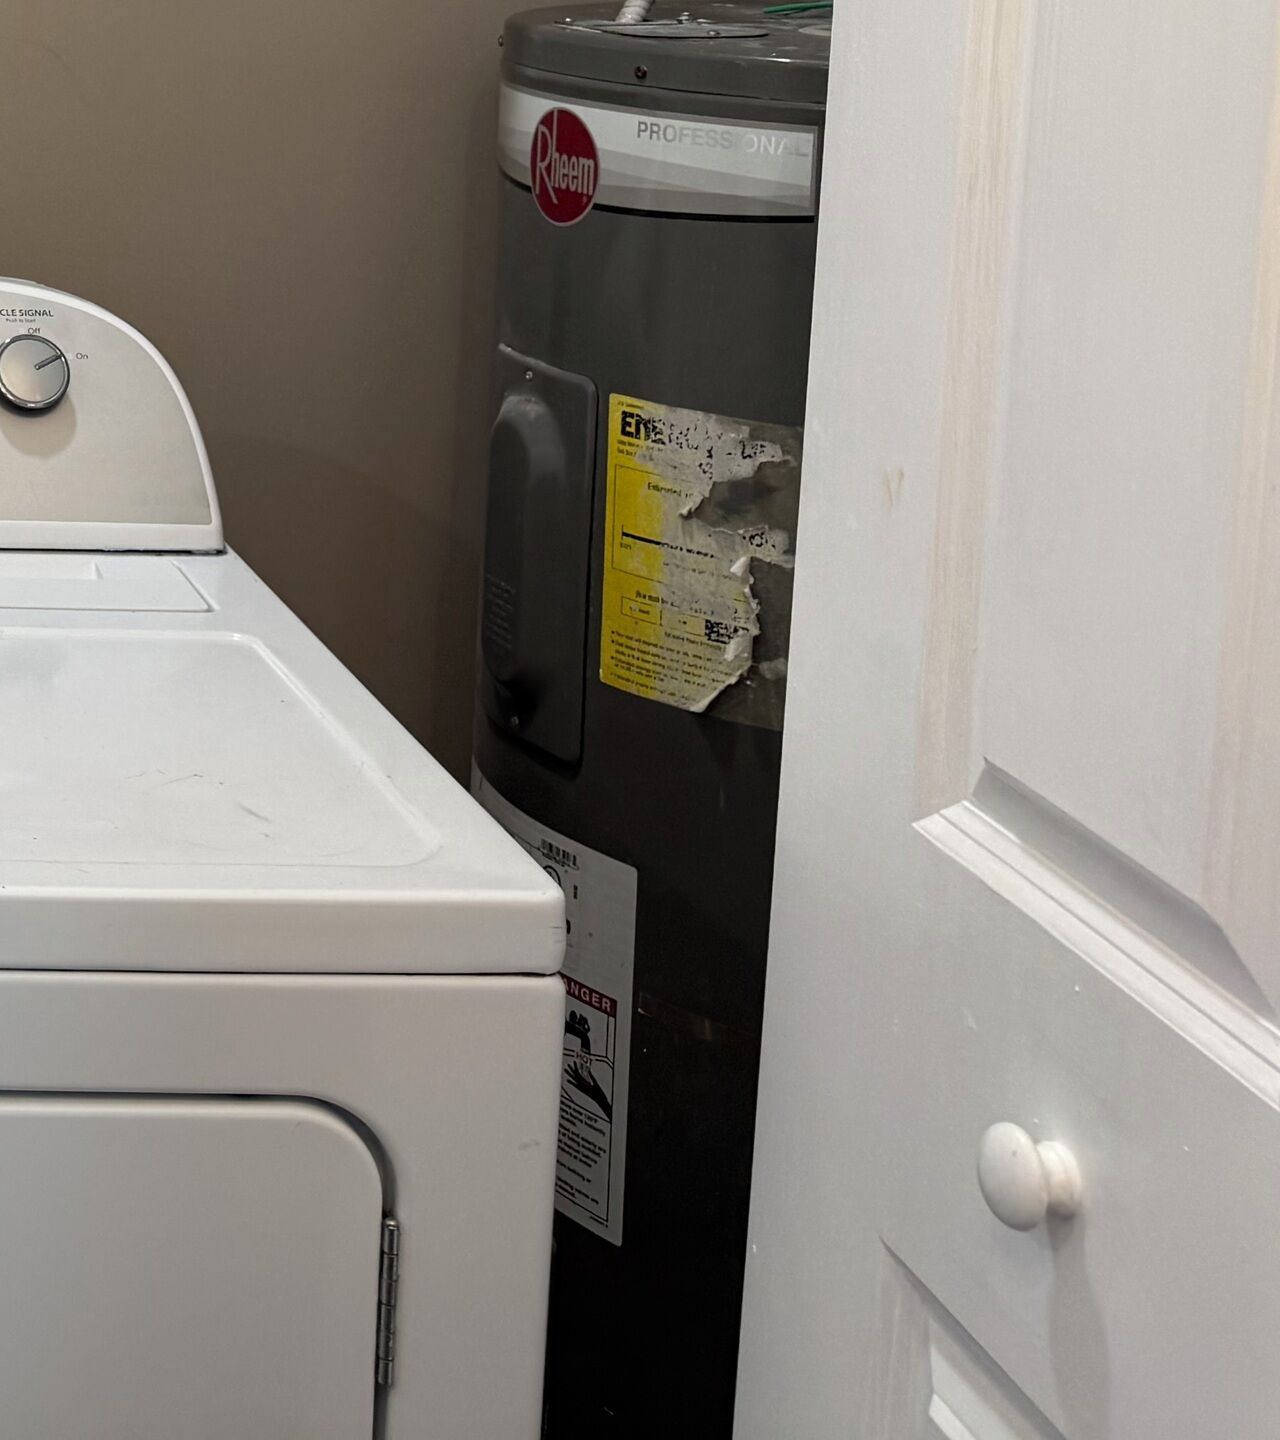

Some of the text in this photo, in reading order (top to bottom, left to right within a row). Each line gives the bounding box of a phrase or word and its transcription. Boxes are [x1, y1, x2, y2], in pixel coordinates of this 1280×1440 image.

[637, 120, 810, 158] PROFESSONAL
[535, 109, 595, 205] Rheem
[18, 308, 55, 318] SIGNAL
[27, 327, 41, 335] Off
[75, 352, 89, 360] On
[563, 978, 612, 1013] NGER
